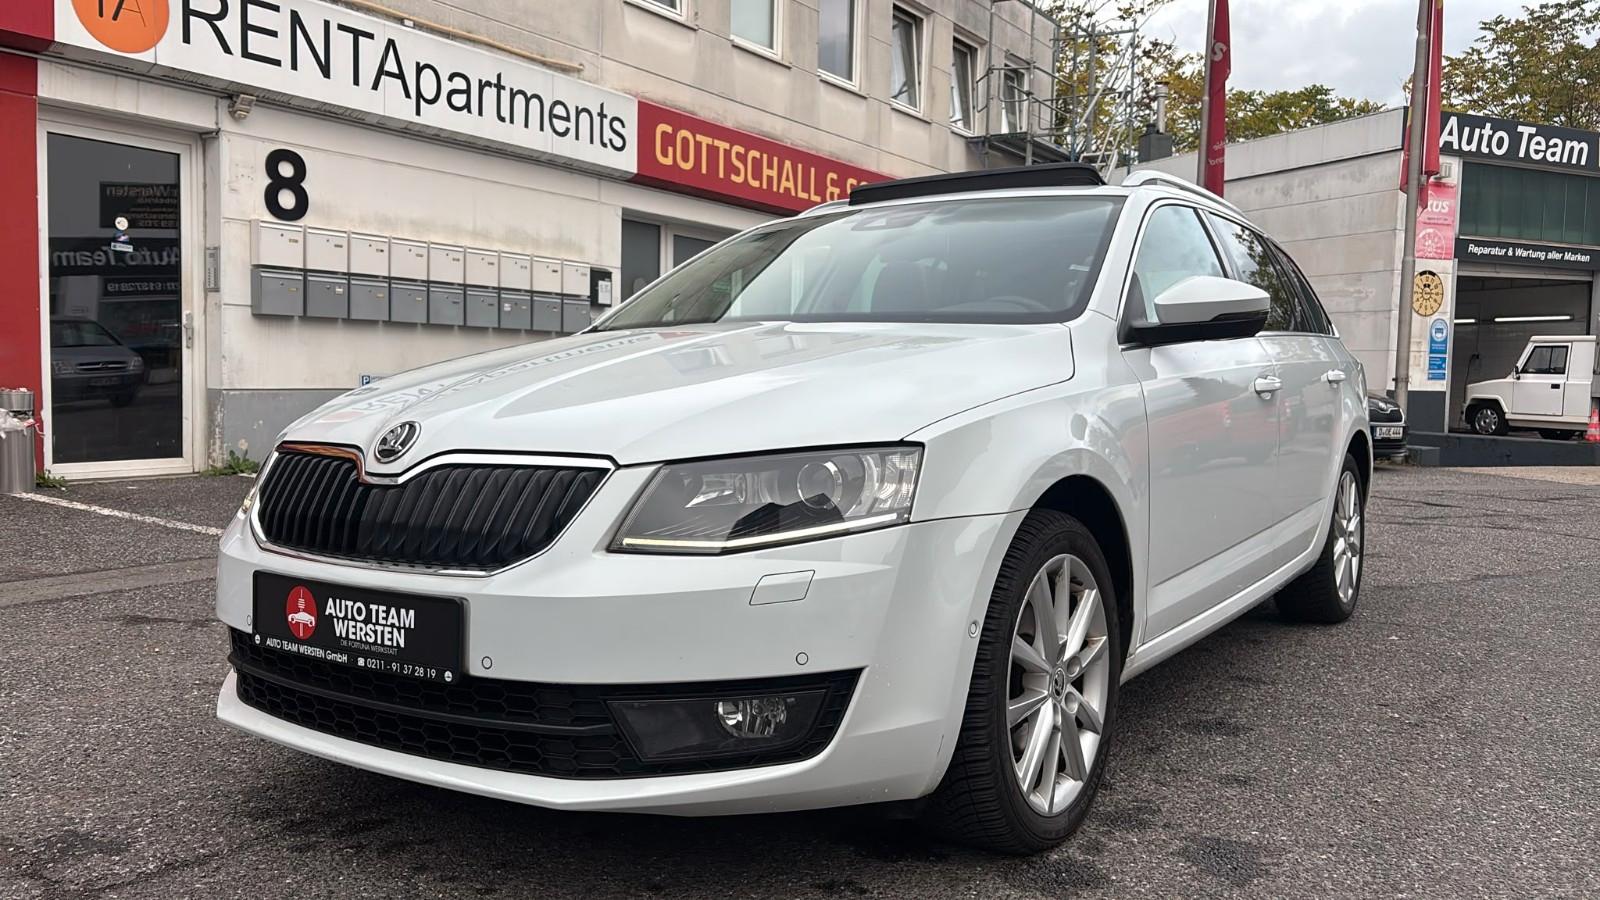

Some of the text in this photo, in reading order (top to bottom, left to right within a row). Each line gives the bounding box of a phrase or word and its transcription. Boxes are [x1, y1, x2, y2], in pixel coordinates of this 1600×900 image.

[1439, 116, 1510, 156] Auto
[1517, 125, 1589, 166] Team
[655, 123, 840, 202] GOTTSCHALL &
[264, 148, 309, 221] 8
[1468, 244, 1590, 262] Reparatur & Wartung aller Marken
[325, 597, 415, 629] AUTO TEAM
[333, 618, 405, 648] WERSTEN
[340, 639, 348, 647] DIE
[348, 640, 370, 650] FORTUNA
[266, 637, 281, 649] AUTO
[282, 640, 298, 652] TEAM
[299, 644, 325, 659] WERSTEN
[326, 650, 348, 663] GmbH
[366, 658, 384, 670] 0211
[392, 662, 400, 673] 91
[403, 664, 412, 674] 37
[414, 666, 424, 677] 28
[427, 668, 436, 679] 19
